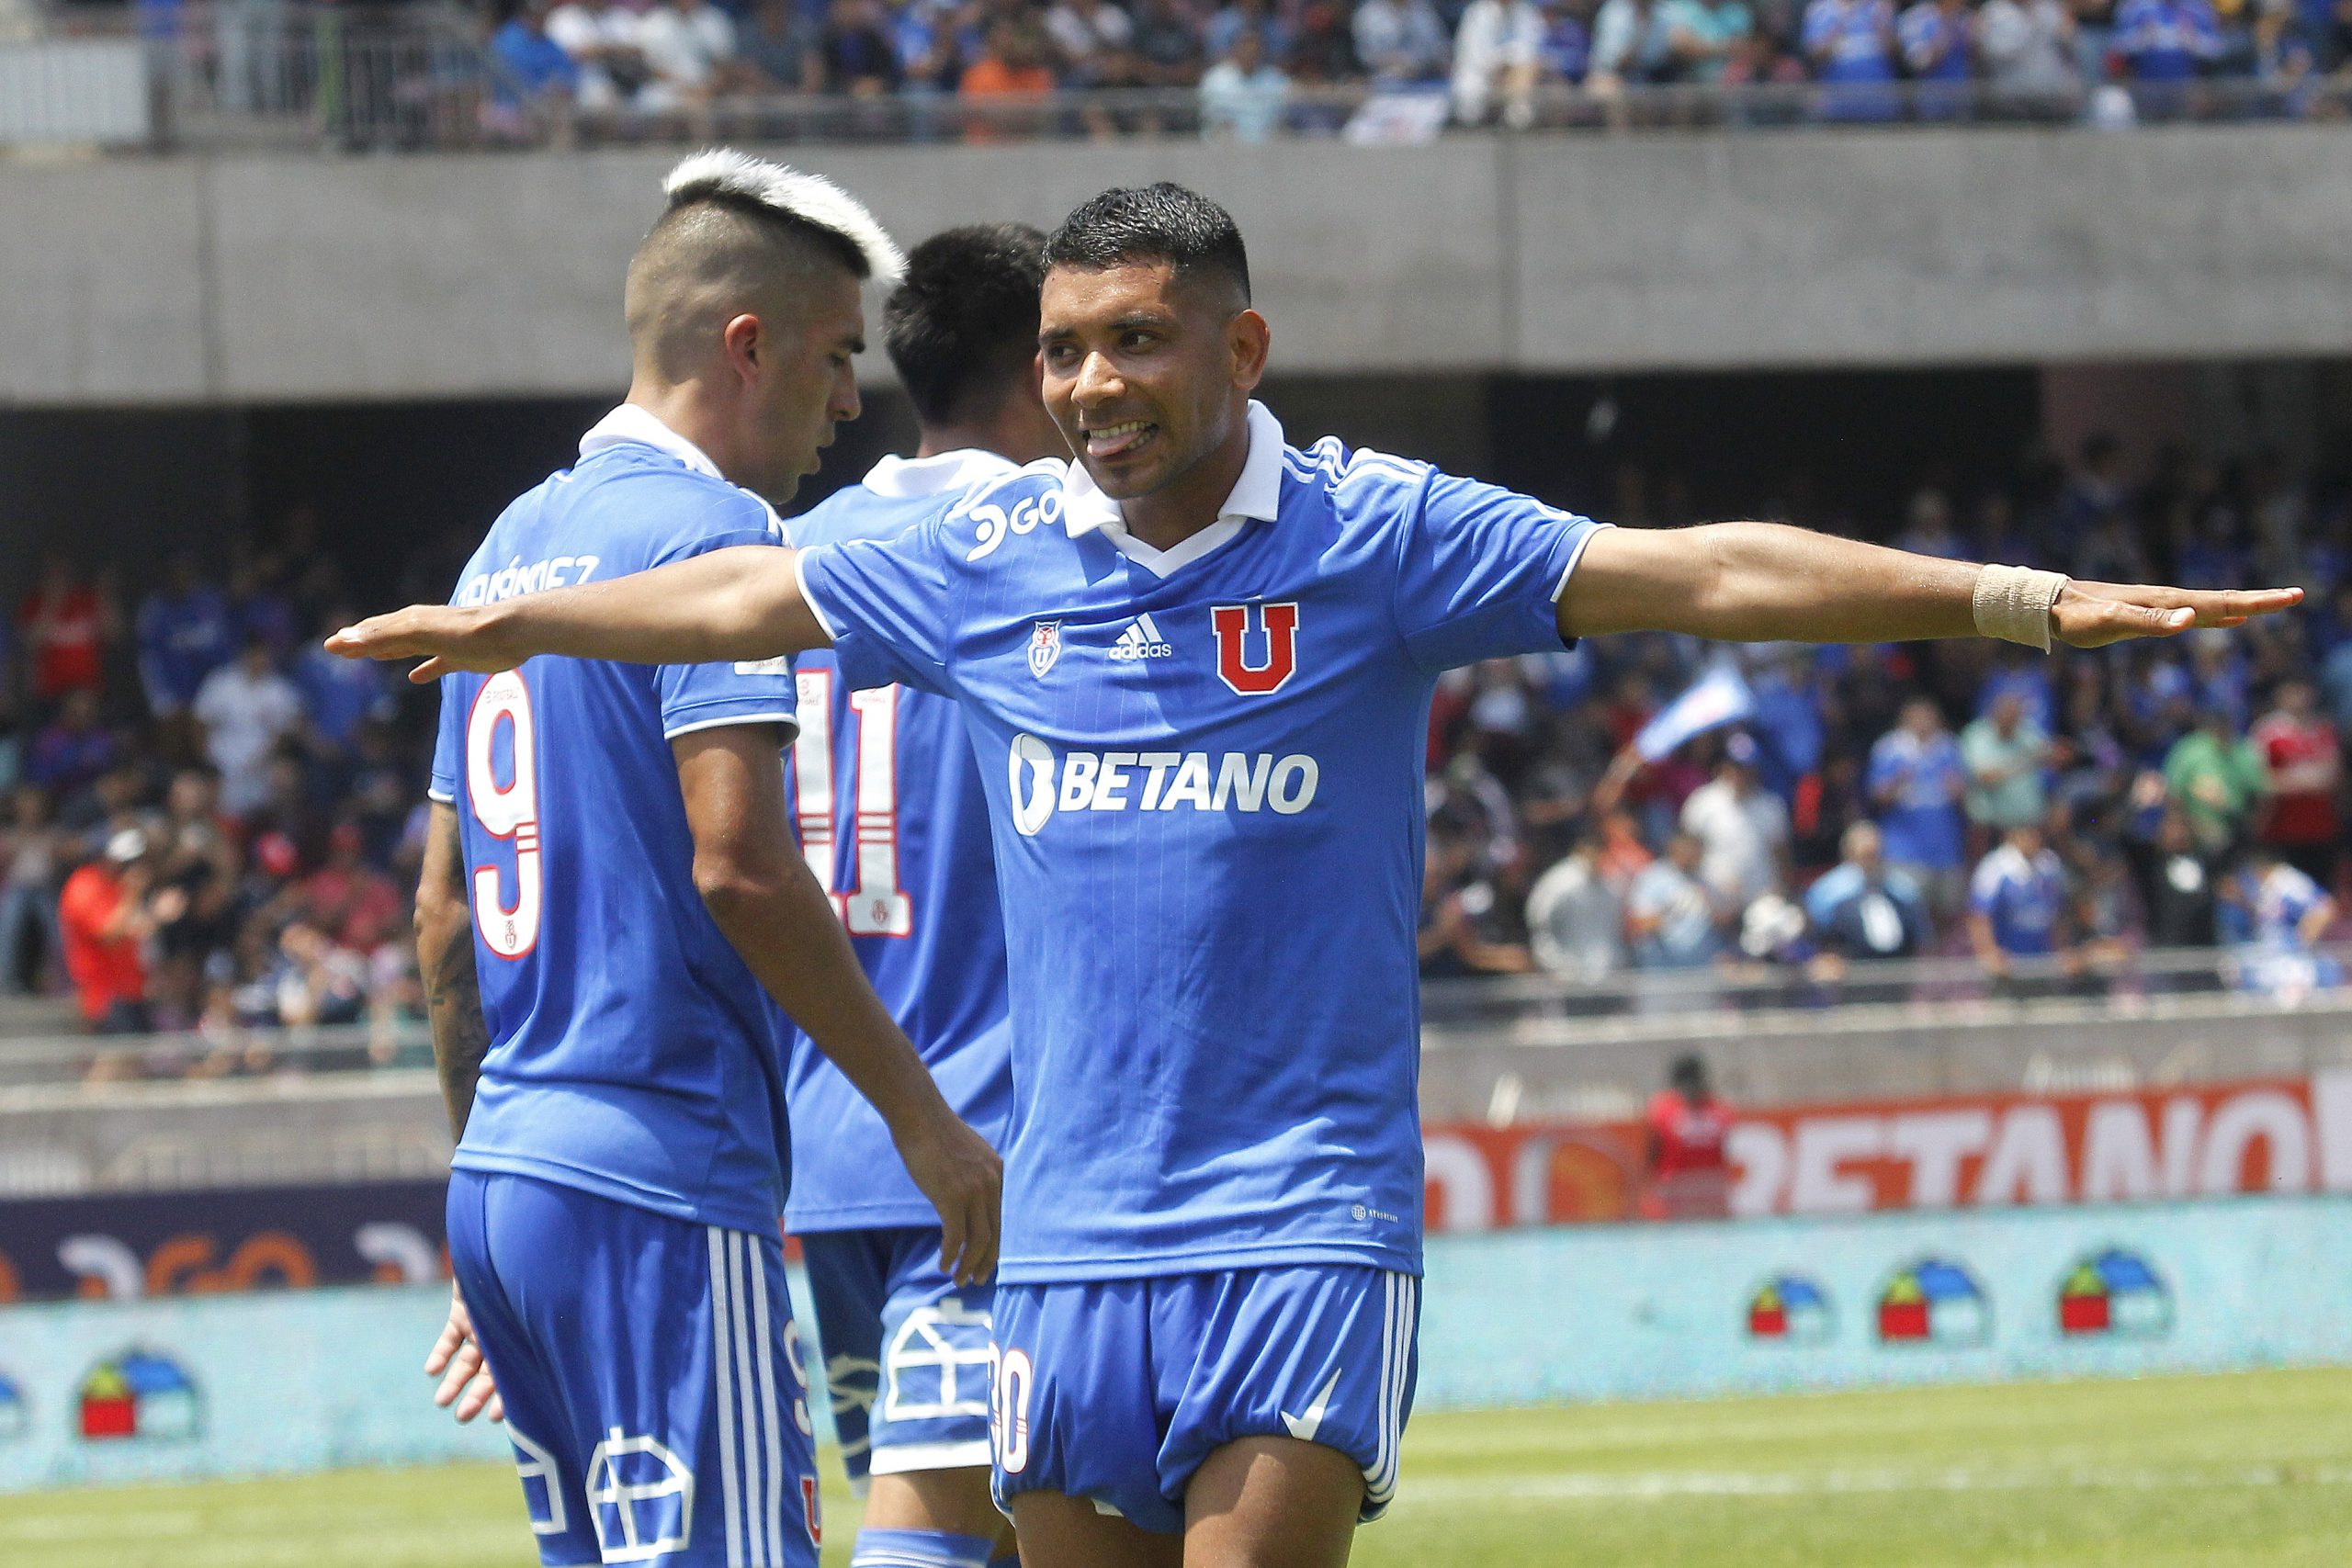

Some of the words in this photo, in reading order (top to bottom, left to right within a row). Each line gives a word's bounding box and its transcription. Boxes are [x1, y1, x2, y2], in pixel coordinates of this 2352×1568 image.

[1108, 641, 1172, 660] adidas
[1210, 602, 1300, 696] U
[466, 667, 540, 961] 9
[792, 668, 911, 938] 11
[1058, 751, 1319, 815] BETANO
